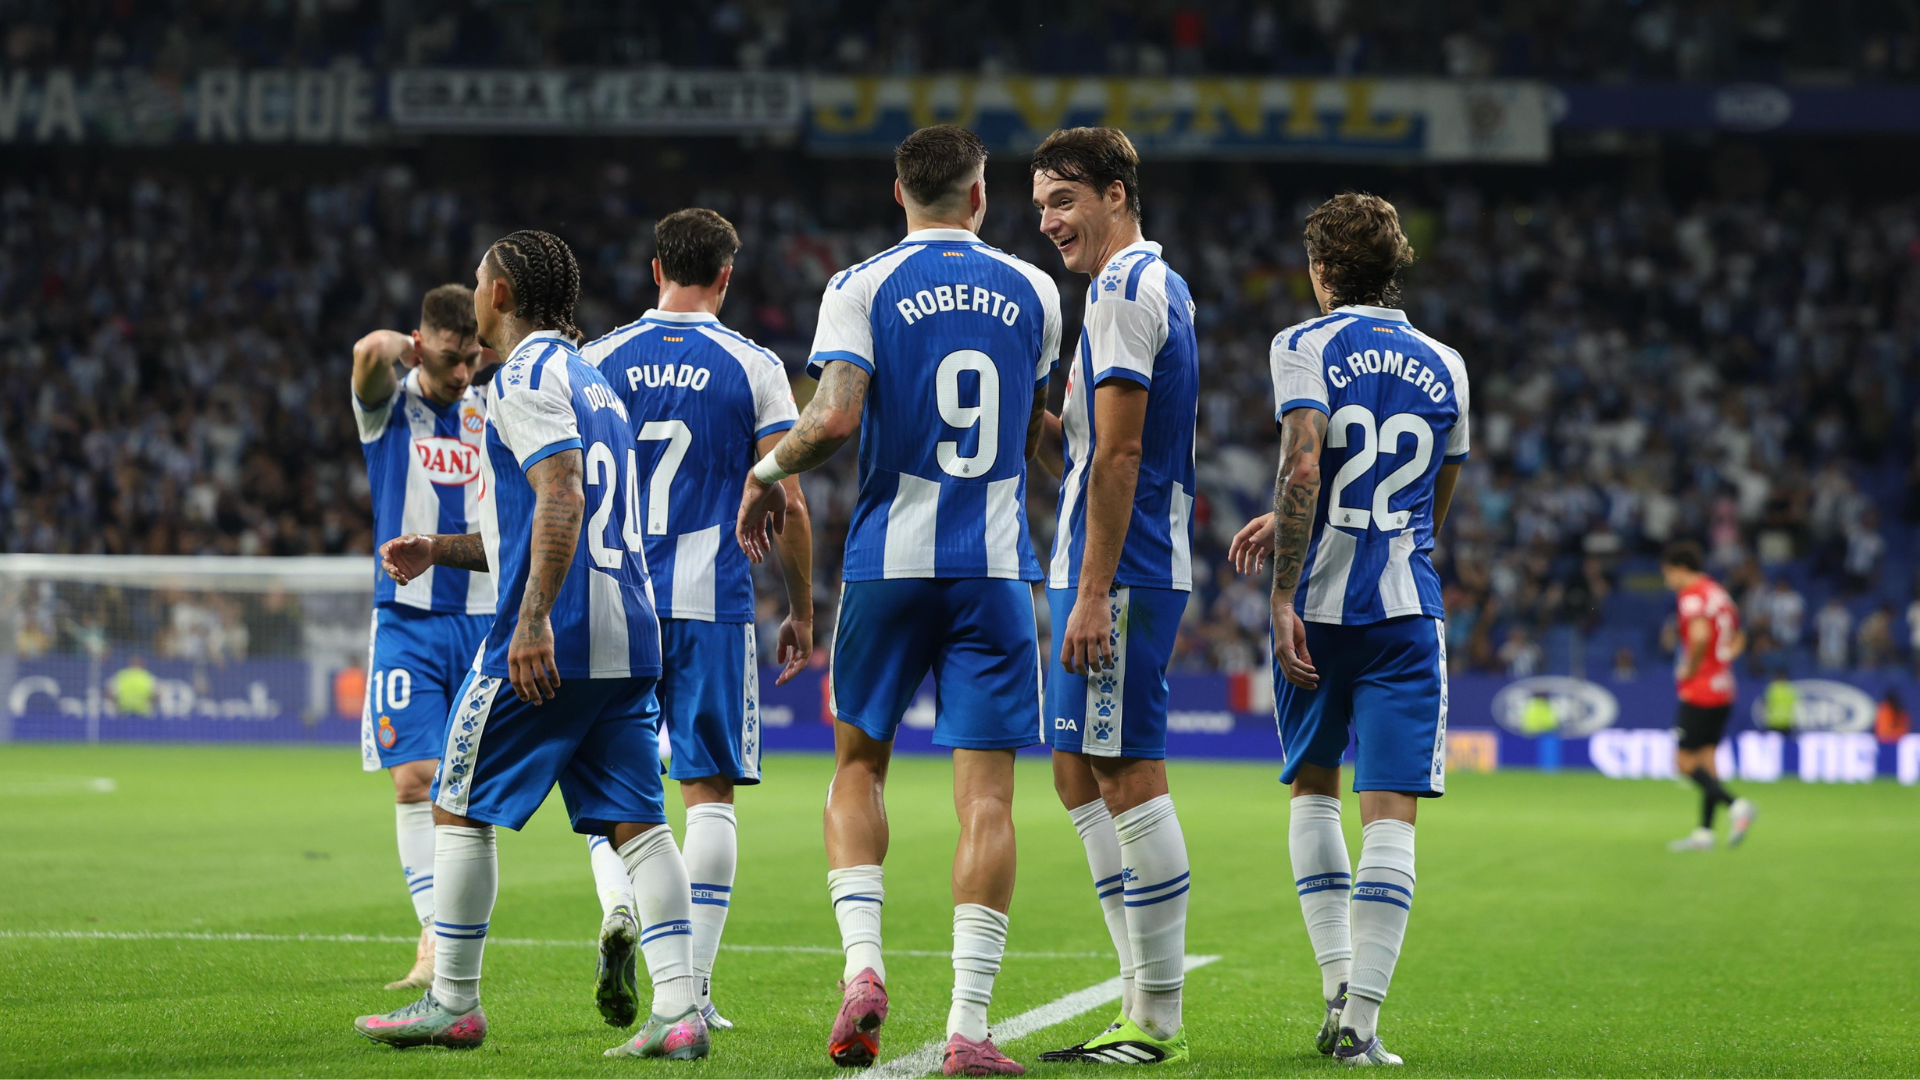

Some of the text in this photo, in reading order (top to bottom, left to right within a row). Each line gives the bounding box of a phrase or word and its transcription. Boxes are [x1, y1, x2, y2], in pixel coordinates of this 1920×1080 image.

[812, 77, 1412, 138] JUVENIL
[896, 283, 1021, 327] ROBERTO
[625, 363, 711, 392] PUADO
[935, 349, 1000, 480] 9
[416, 444, 473, 475] DANI
[636, 419, 693, 536] 7
[1327, 404, 1435, 532] 22
[586, 441, 649, 575] 24
[373, 668, 412, 714] 10
[1306, 878, 1335, 888] RCDE
[1358, 886, 1389, 897] RCDE
